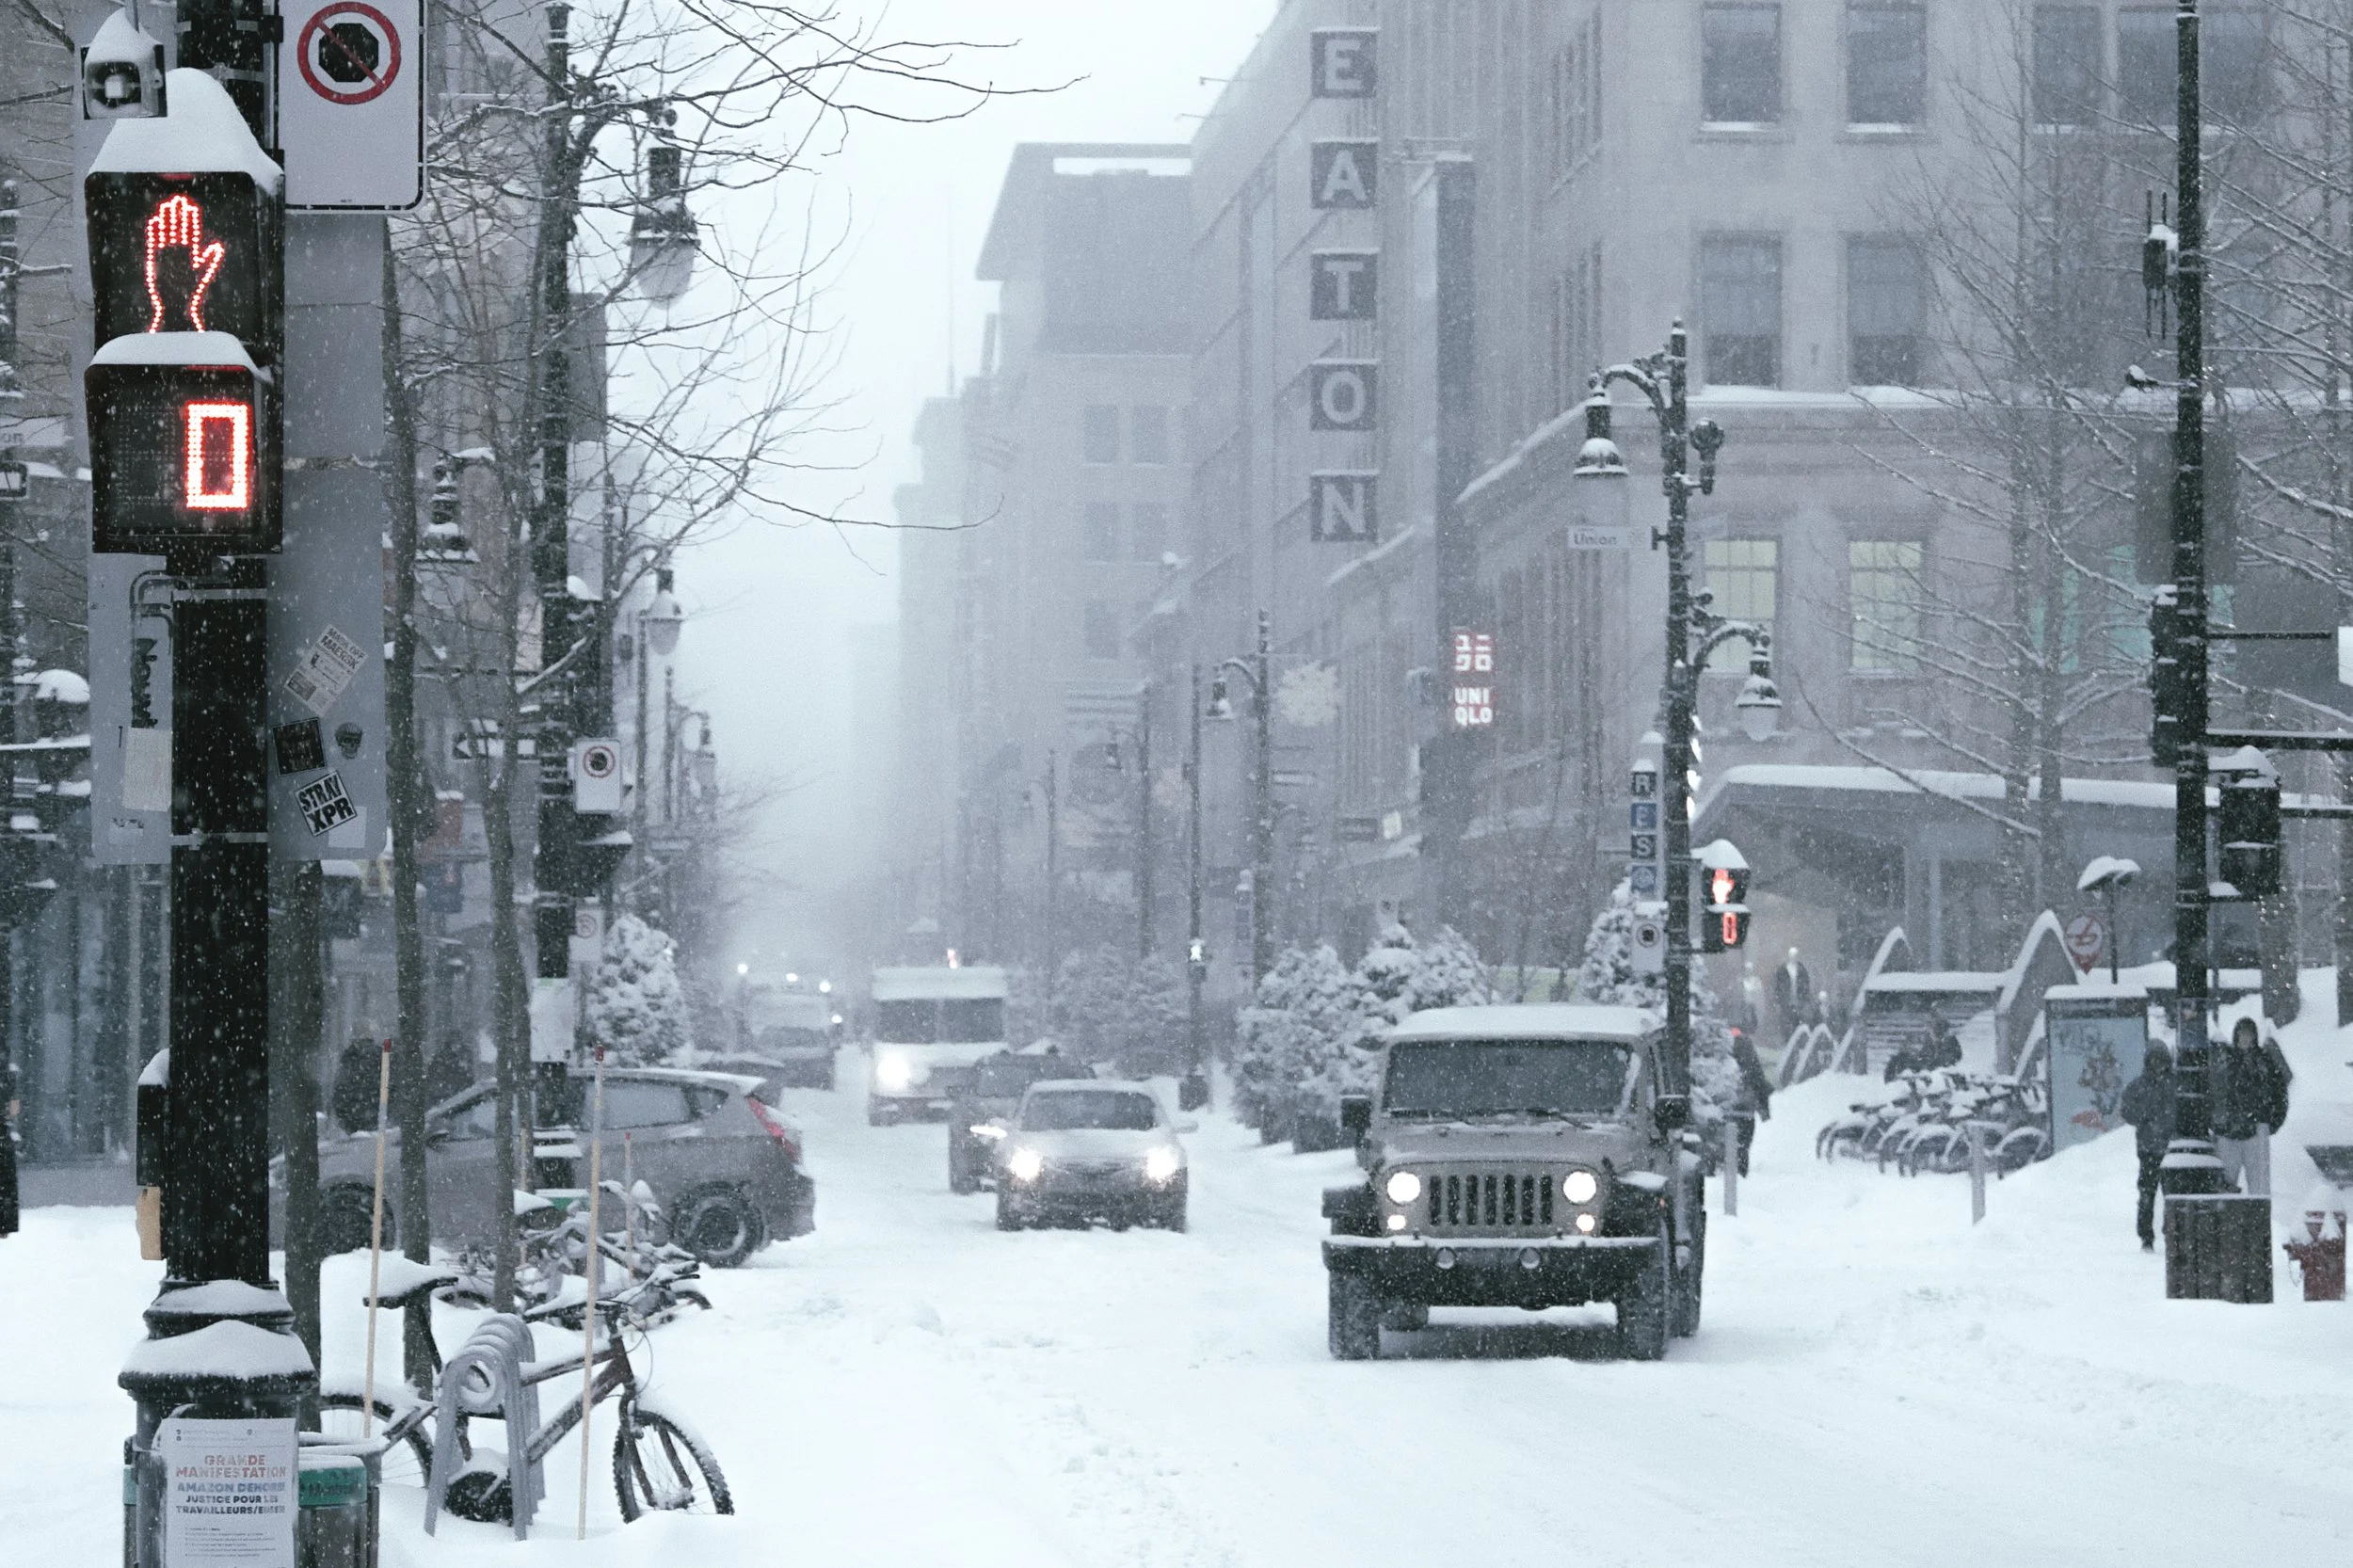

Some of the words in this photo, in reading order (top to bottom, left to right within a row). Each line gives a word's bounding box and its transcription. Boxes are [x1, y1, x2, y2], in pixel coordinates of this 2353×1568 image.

[1321, 40, 1367, 535] EATON
[186, 401, 250, 509] 0
[321, 635, 359, 669] MAERSK
[348, 644, 365, 659] OFF
[1454, 687, 1490, 705] UNI
[1454, 706, 1493, 727] QLO
[298, 775, 343, 812] STRAY
[307, 797, 354, 833] XPR
[204, 1454, 266, 1465] GRANDE
[176, 1466, 286, 1478] MANIFESTATION
[1573, 1474, 1617, 1487] Union
[177, 1482, 233, 1493] AMAZON
[185, 1495, 231, 1504] JUSTICE
[232, 1495, 262, 1504] POUR
